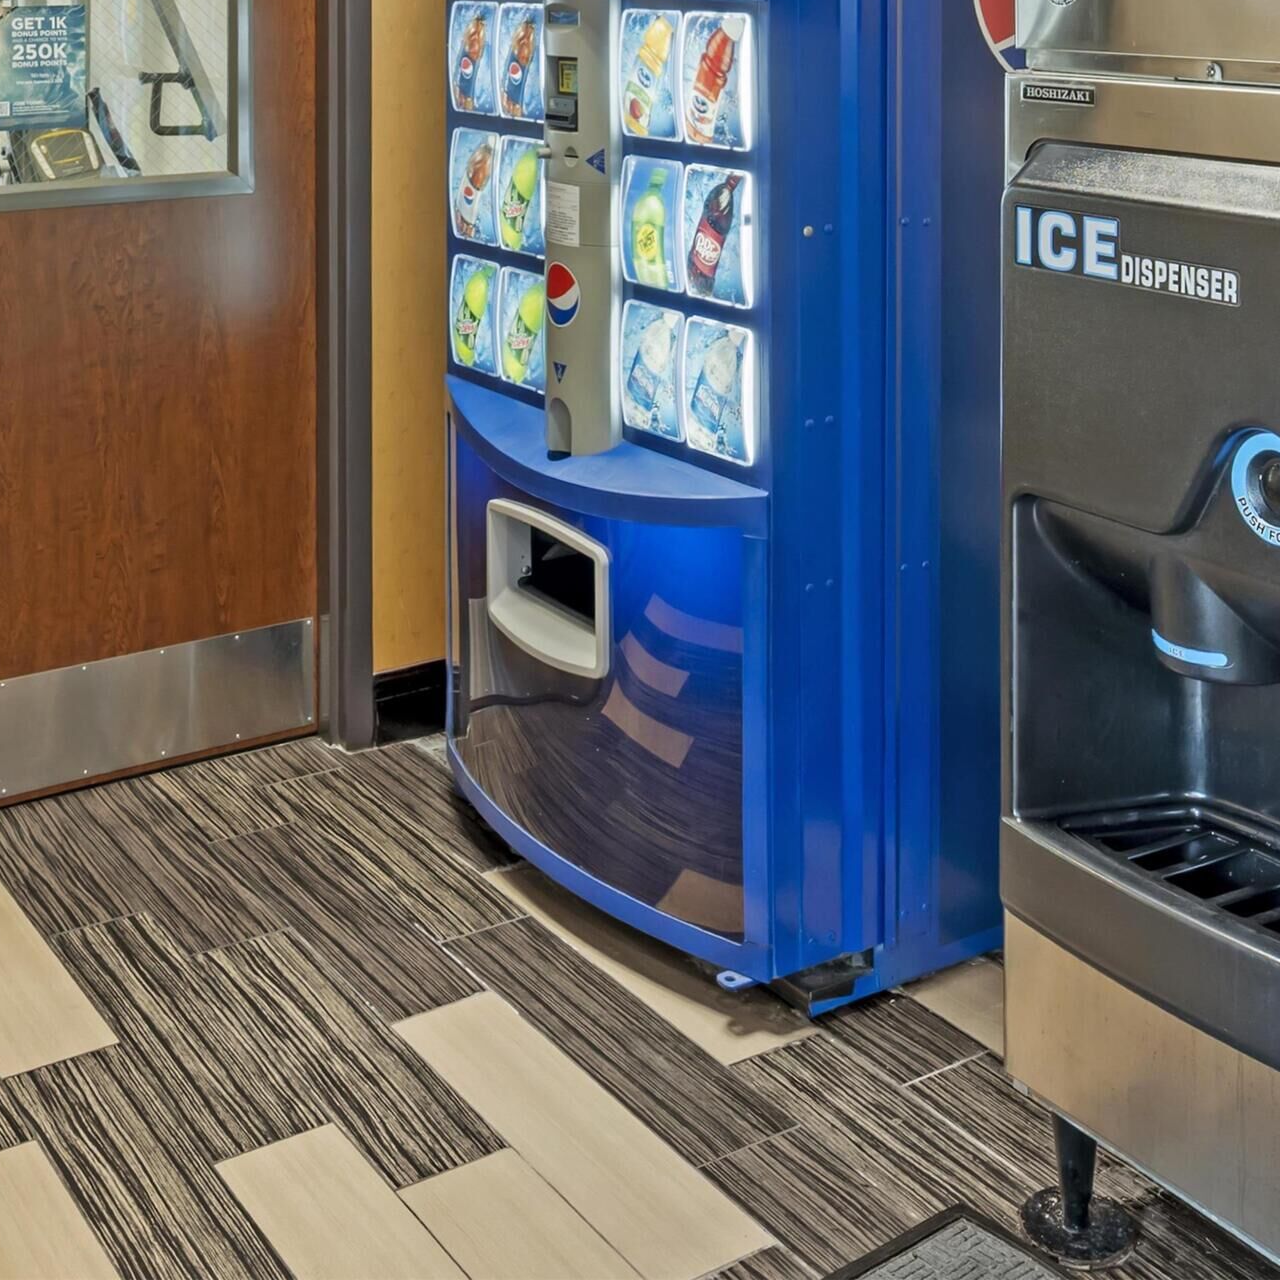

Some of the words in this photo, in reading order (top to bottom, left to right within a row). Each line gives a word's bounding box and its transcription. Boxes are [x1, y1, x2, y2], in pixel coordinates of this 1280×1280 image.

[11, 17, 45, 30] GET
[49, 16, 67, 29] 1K
[11, 30, 38, 38] BONUS
[12, 42, 67, 60] 250K
[1027, 87, 1090, 102] HOSHIZAKI
[1016, 206, 1118, 280] ICE
[1121, 254, 1238, 304] DISPENSER
[1238, 497, 1265, 535] PUSH
